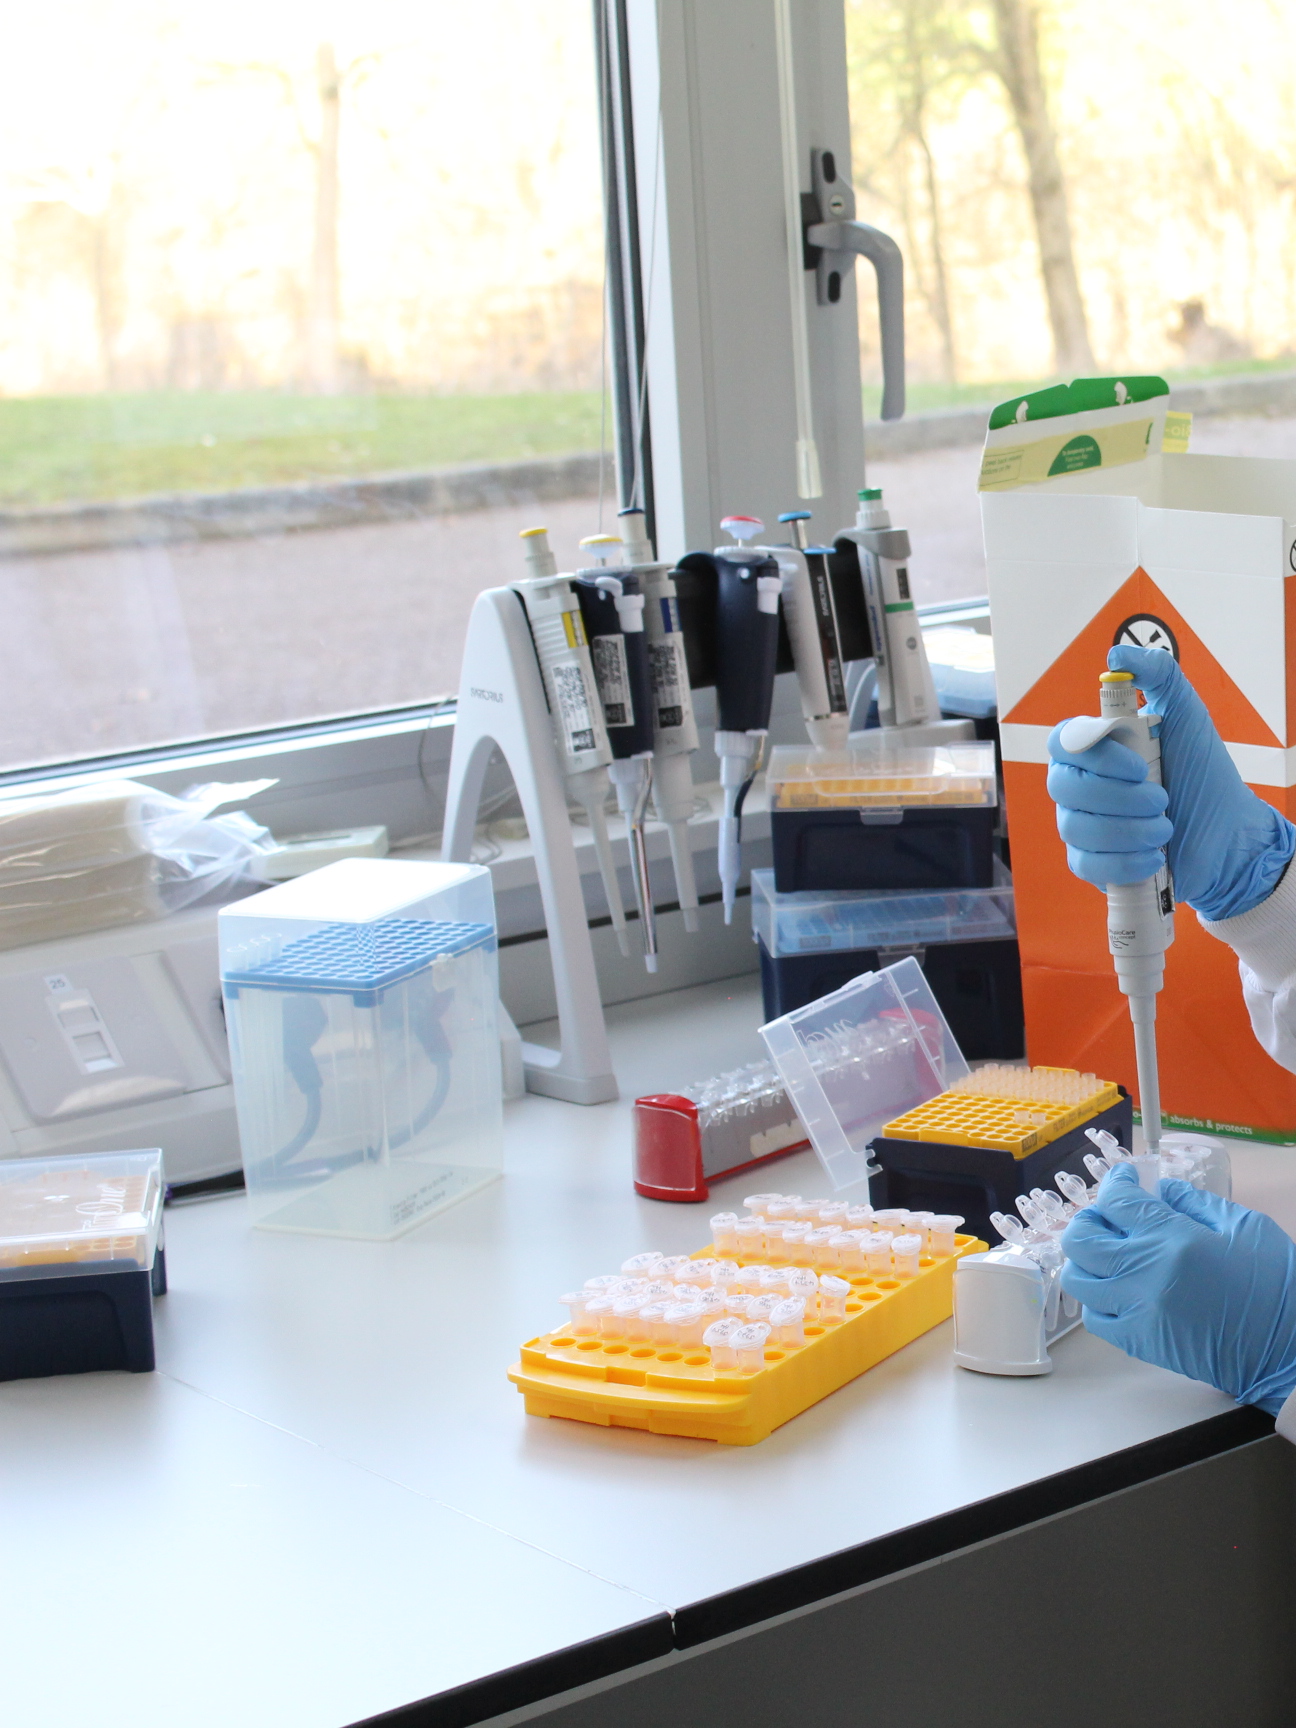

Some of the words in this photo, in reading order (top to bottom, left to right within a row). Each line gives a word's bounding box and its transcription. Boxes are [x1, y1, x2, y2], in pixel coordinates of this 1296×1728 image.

[1169, 1115, 1204, 1128] absorbs
[1206, 1119, 1214, 1129] &
[1215, 1122, 1253, 1135] protects
